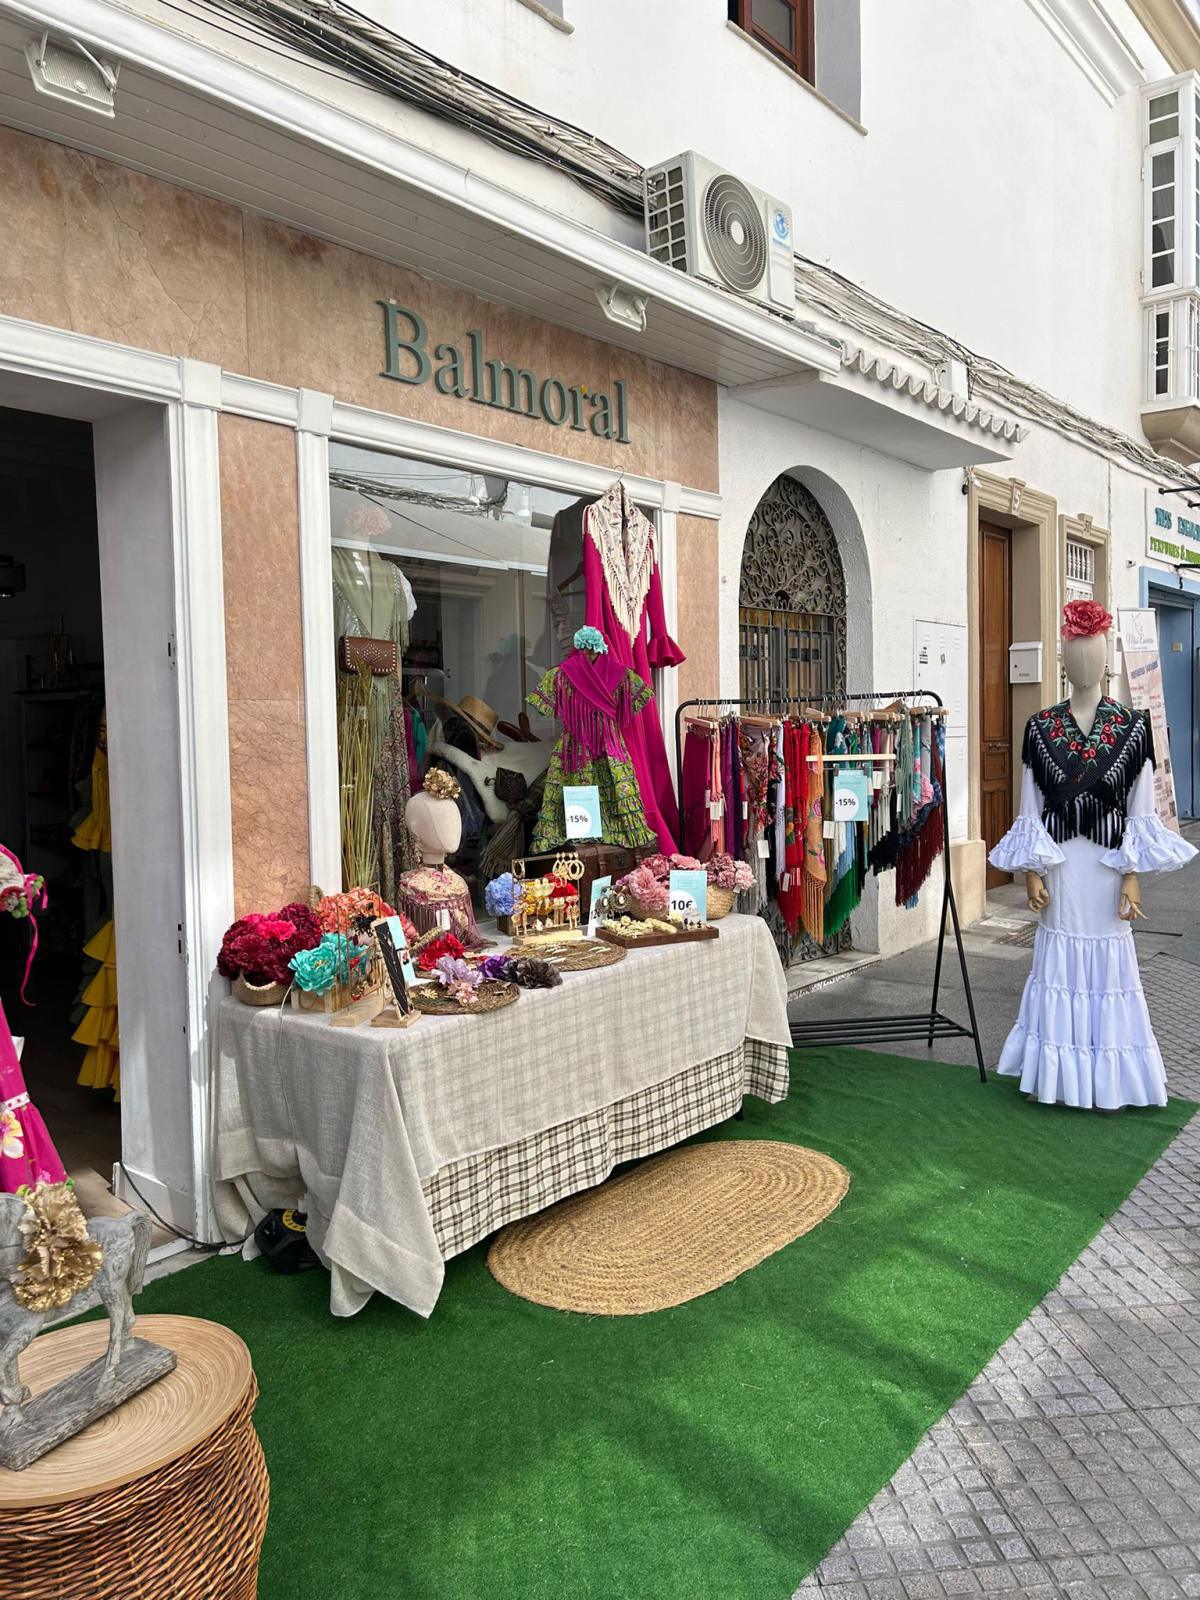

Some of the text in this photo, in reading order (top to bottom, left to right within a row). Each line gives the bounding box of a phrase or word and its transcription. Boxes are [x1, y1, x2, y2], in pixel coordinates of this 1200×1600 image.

[376, 299, 632, 444] Balmoral
[836, 798, 856, 806] -15%
[567, 815, 588, 823] -15%
[671, 900, 693, 910] 10€
